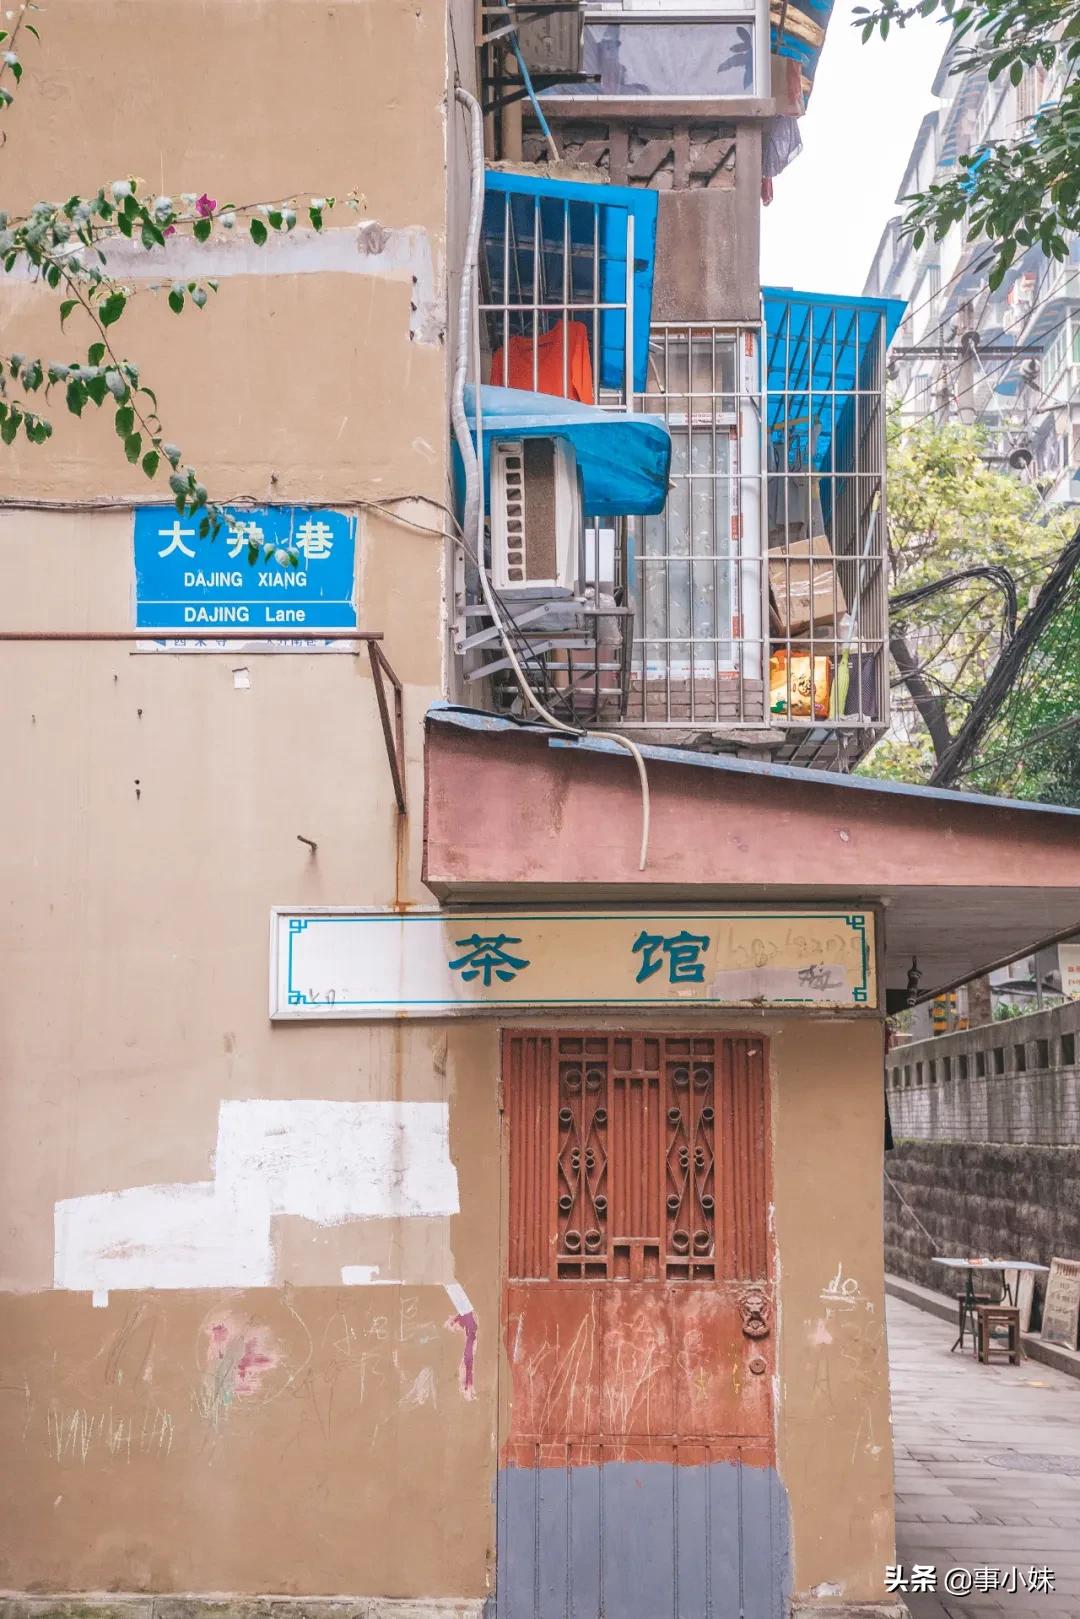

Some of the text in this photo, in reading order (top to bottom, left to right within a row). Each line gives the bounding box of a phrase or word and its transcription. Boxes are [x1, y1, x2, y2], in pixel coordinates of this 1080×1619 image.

[158, 520, 334, 560] 大井巷
[184, 571, 307, 587] DAJING XIANG
[184, 606, 306, 622] DAJING Lane
[448, 931, 711, 986] 茶馆
